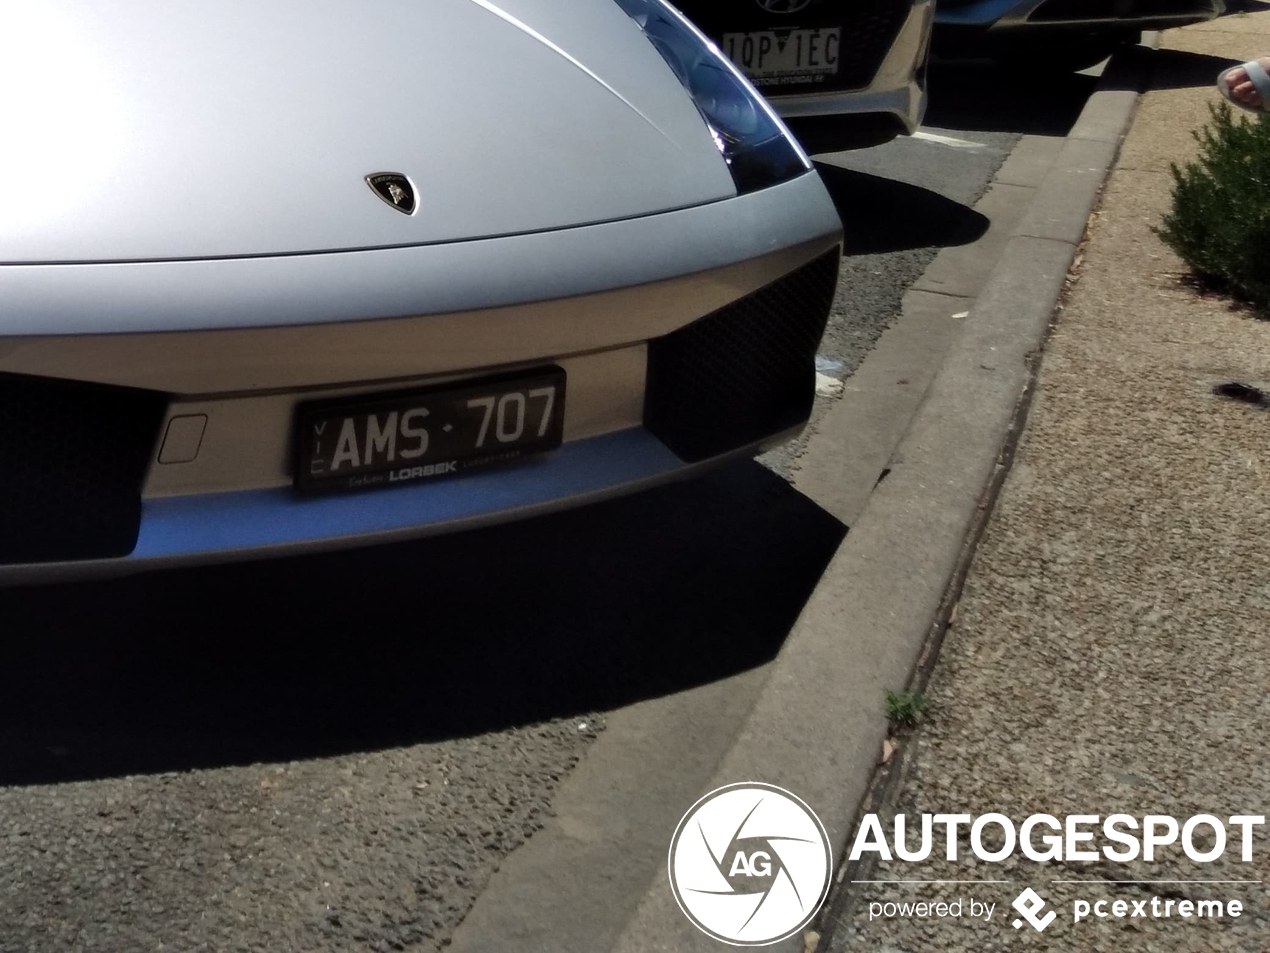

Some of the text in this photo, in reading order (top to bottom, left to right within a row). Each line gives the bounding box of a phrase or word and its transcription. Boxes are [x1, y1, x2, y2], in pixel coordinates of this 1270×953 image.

[796, 33, 838, 67] 1EC
[780, 75, 813, 85] HYUNDAI
[330, 386, 556, 471] AMS 707
[389, 460, 458, 482] LORBEK
